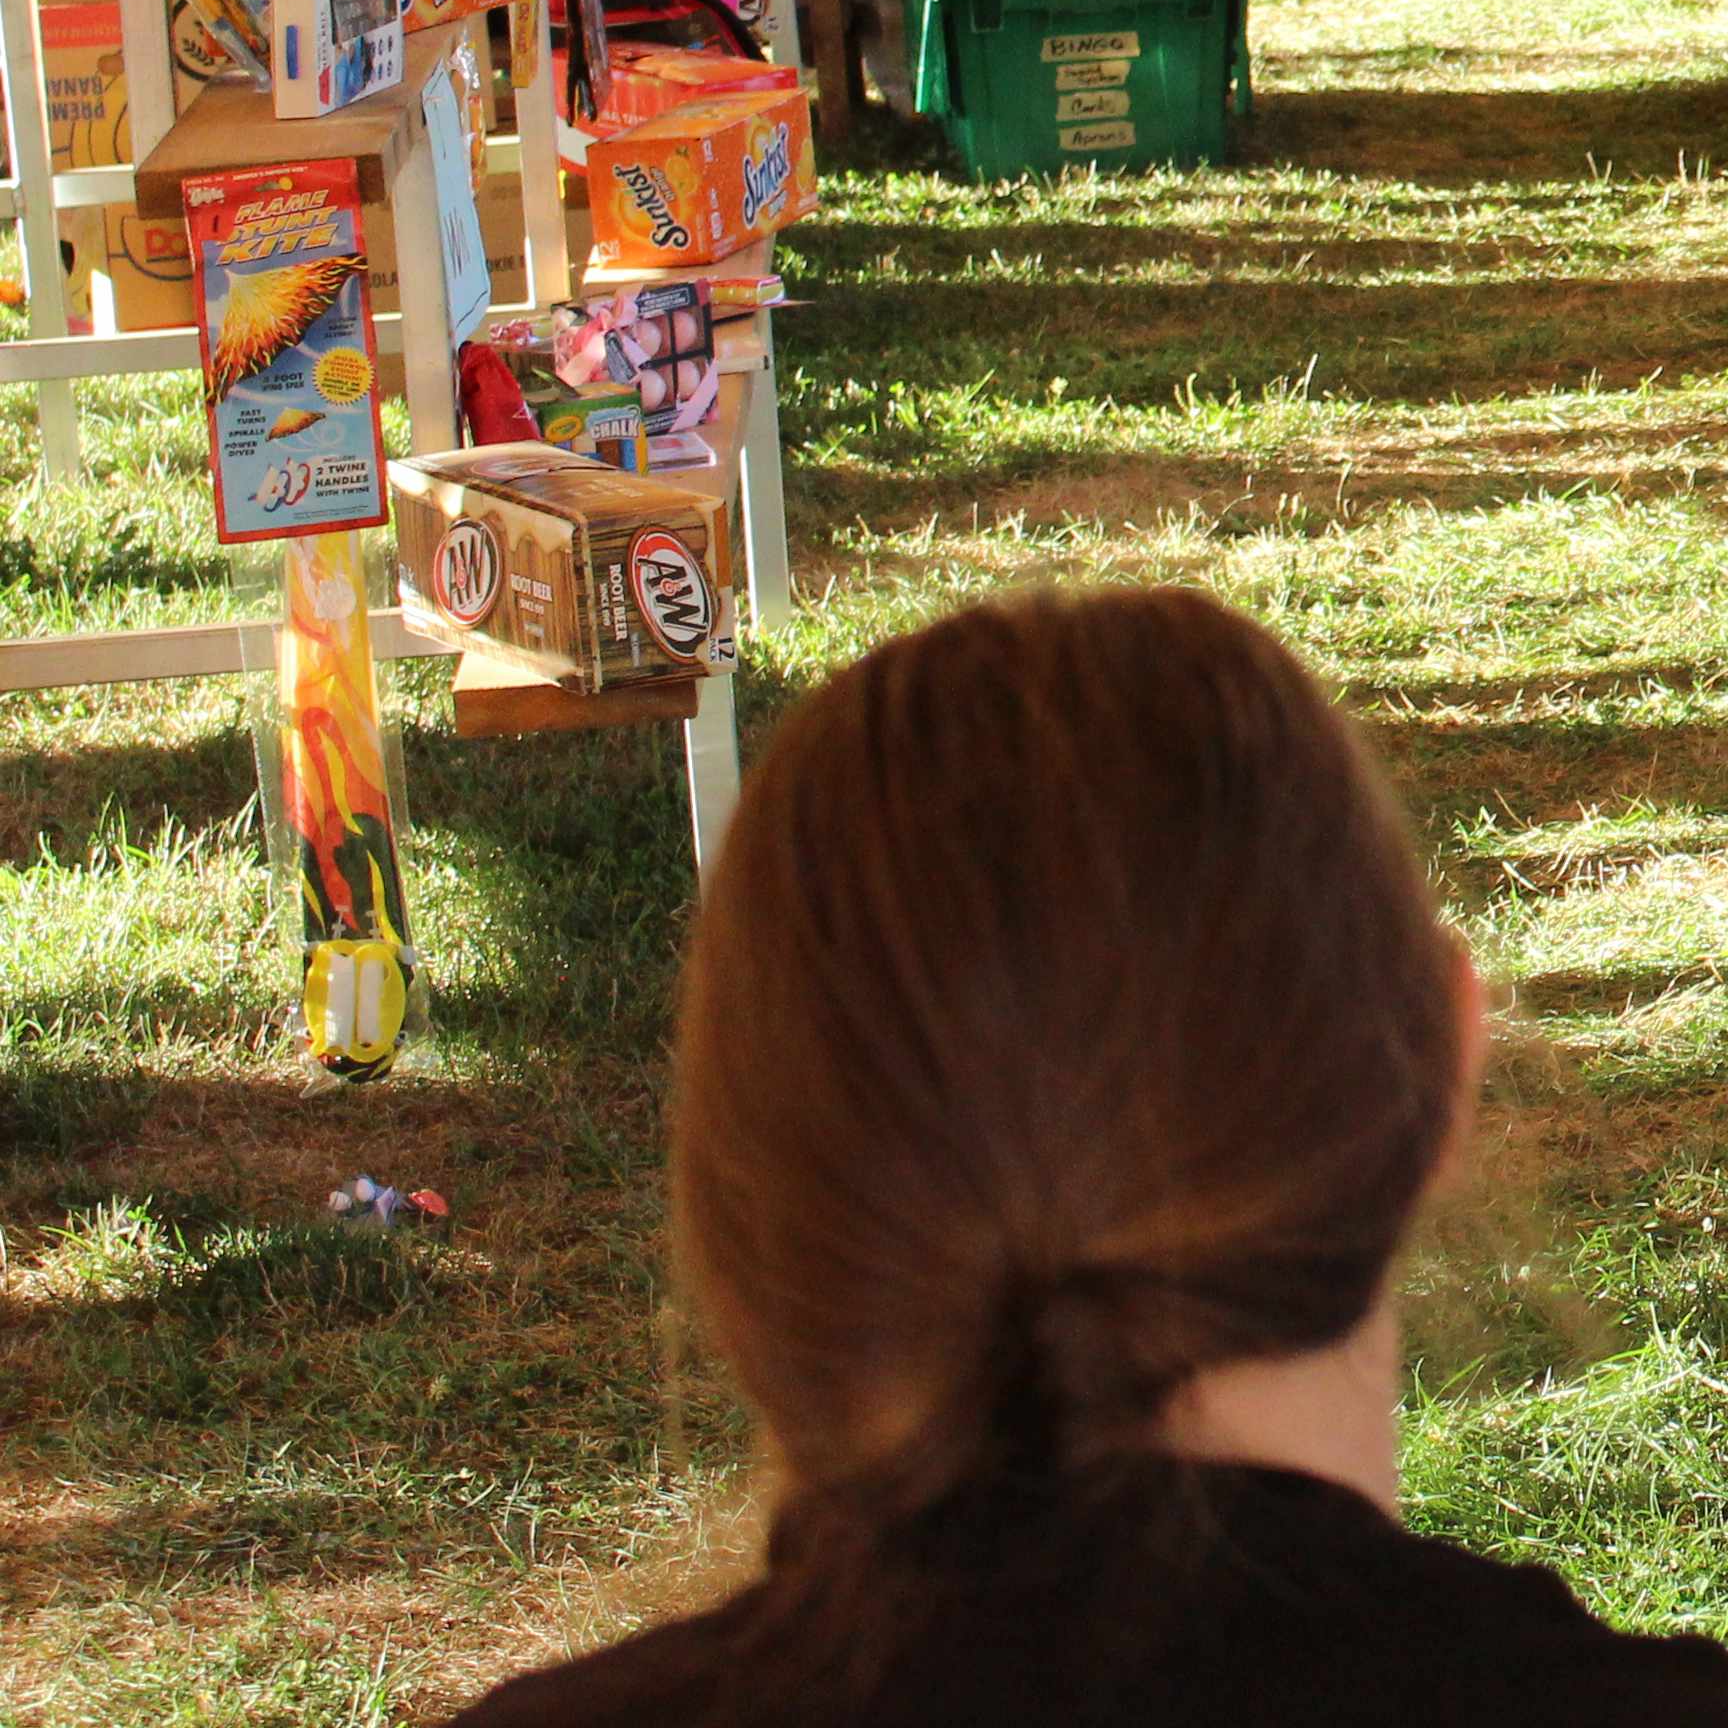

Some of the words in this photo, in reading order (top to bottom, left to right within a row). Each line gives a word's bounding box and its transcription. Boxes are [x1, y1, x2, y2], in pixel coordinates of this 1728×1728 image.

[1050, 37, 1125, 56] BINGO
[743, 123, 789, 229] Sunkist
[233, 190, 329, 226] FLAME
[613, 163, 690, 250] Sunkist
[216, 223, 339, 266] KITE
[274, 372, 303, 383] FOOT
[237, 415, 267, 425] TURNS
[240, 408, 262, 418] FAST
[228, 428, 265, 438] SPIRALS
[591, 418, 641, 439] CHALK
[224, 440, 258, 450] POWER
[315, 466, 324, 476] 2
[327, 462, 367, 474] TWINE
[315, 473, 370, 488] HANDLES
[316, 486, 341, 498] WITH
[342, 485, 371, 496] TWINE
[511, 573, 532, 595] ROOT
[533, 580, 554, 602] BEER
[608, 562, 626, 603] ROOT
[635, 556, 709, 633] A&W
[613, 606, 628, 642] BEER
[709, 638, 718, 664] PACK
[718, 636, 736, 663] 12
